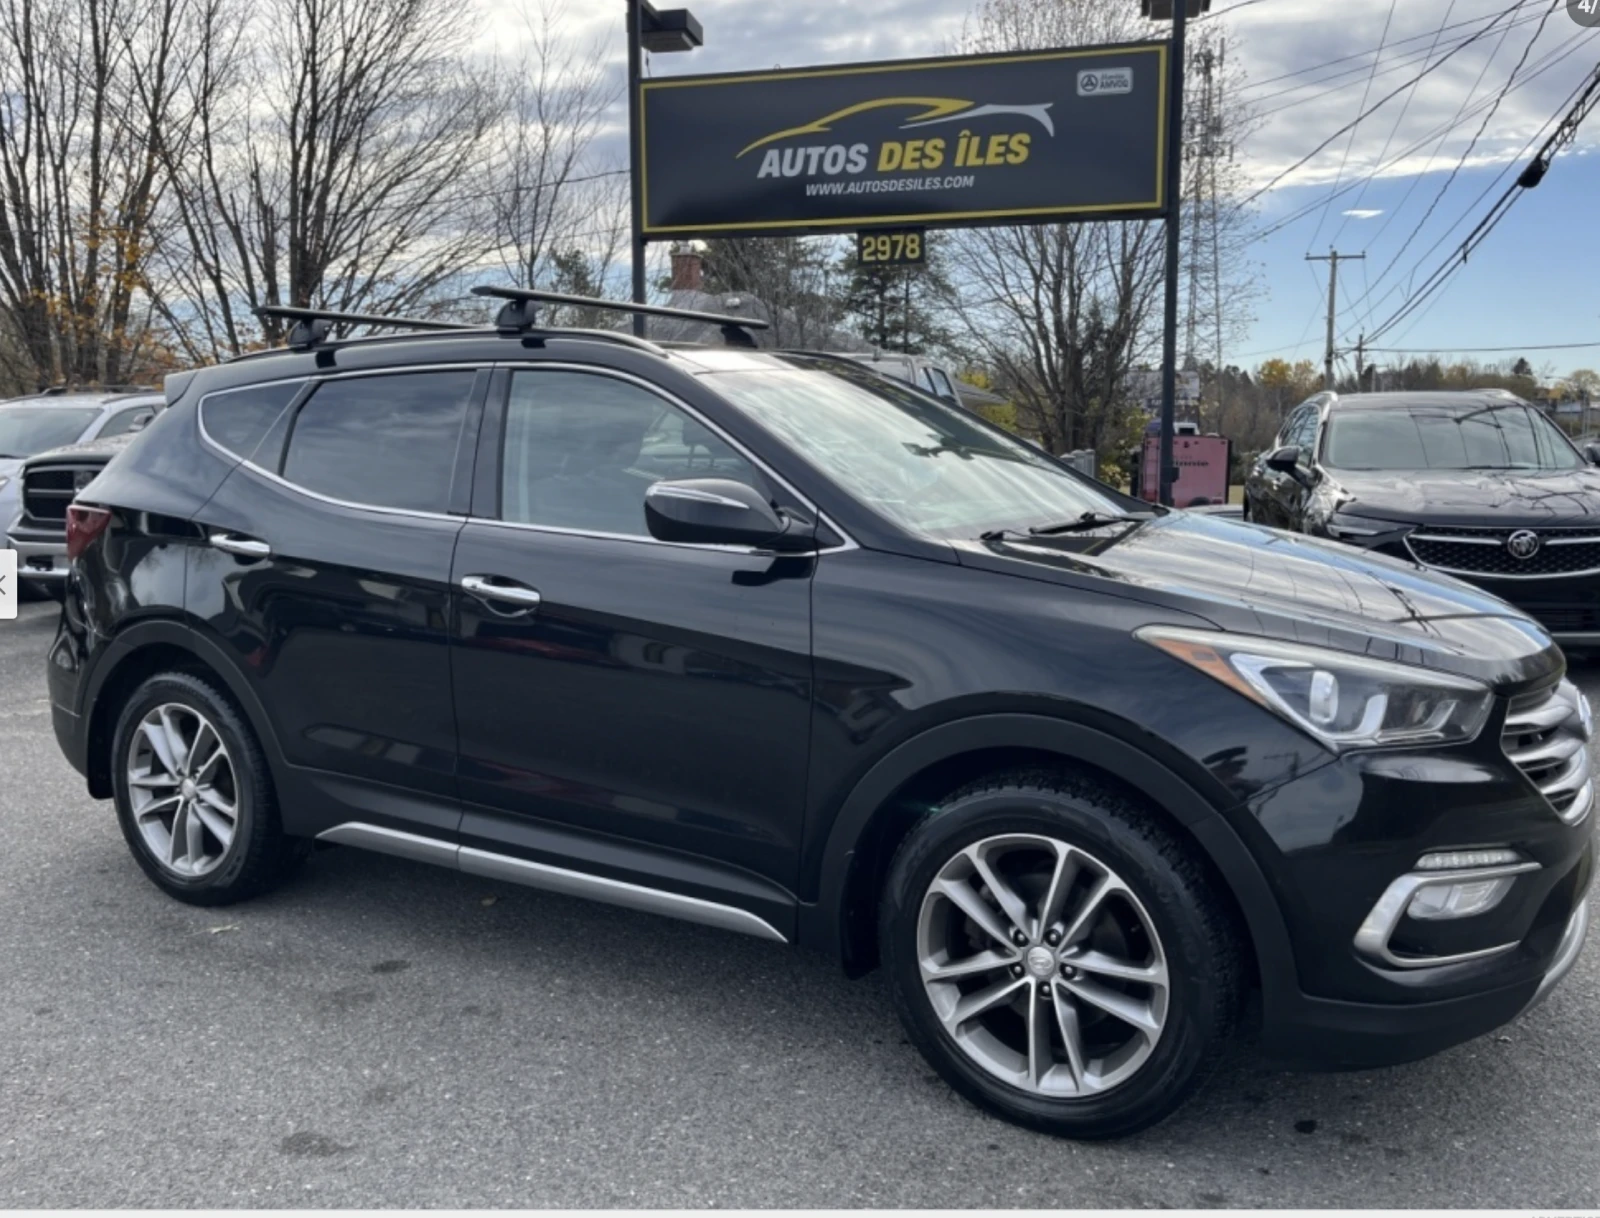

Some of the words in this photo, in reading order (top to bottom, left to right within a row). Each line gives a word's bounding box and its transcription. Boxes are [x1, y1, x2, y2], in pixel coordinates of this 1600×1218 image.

[757, 144, 868, 178] AUTOS
[877, 139, 945, 171] DES
[954, 129, 1031, 166] ÎLES
[806, 176, 974, 196] WWW.AUTOSDESILES.COM
[862, 234, 920, 261] 2978
